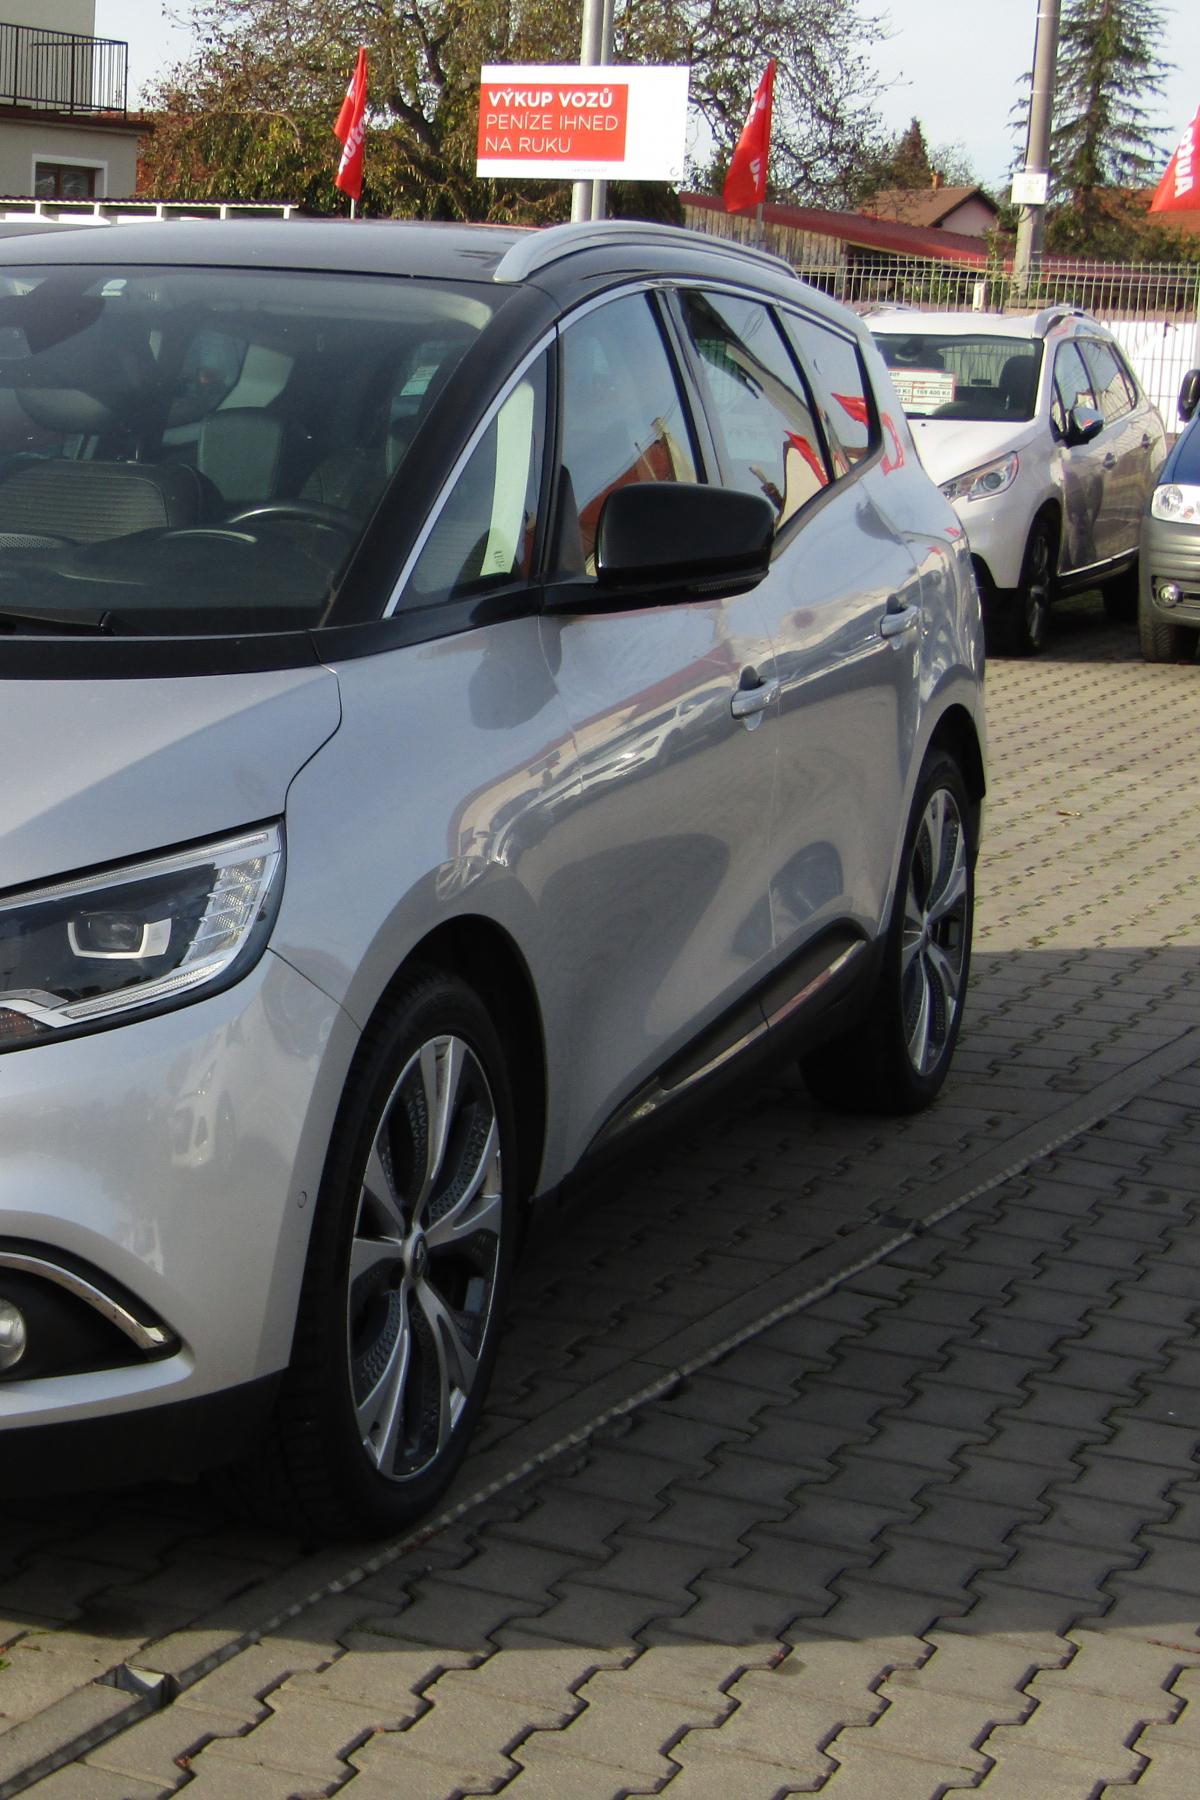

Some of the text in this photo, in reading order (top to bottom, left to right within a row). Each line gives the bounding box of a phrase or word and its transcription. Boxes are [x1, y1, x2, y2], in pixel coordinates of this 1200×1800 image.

[488, 88, 613, 108] VÝKUP VOZŮ
[486, 112, 618, 131] PENÍZE IHNED
[484, 137, 571, 153] NA RUKU
